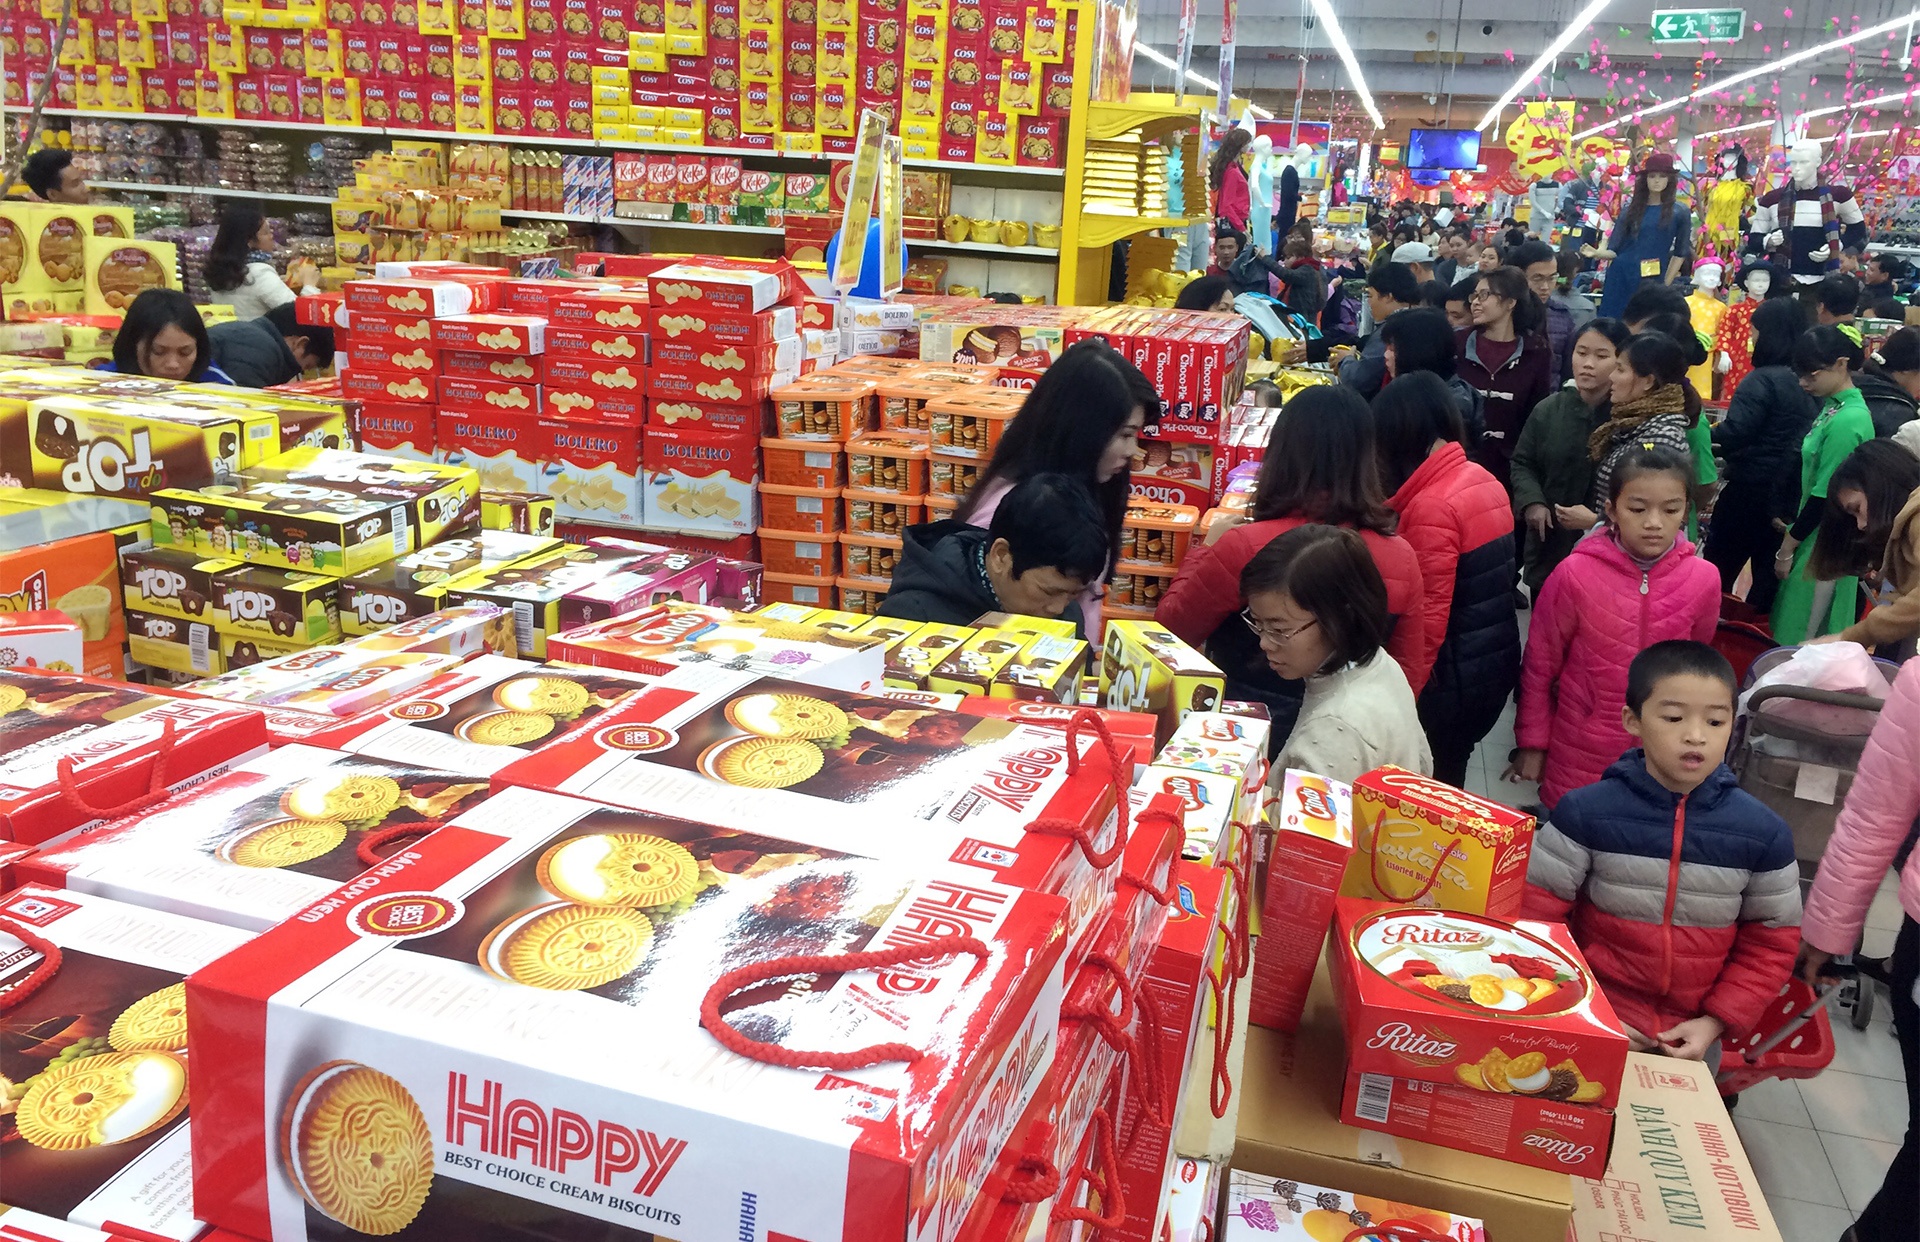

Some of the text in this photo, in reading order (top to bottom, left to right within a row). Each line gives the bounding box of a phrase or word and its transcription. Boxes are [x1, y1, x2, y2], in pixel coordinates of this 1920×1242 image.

[566, 0, 586, 9] COSY
[602, 8, 622, 17] COSY
[714, 4, 734, 14] COSY
[996, 17, 1018, 26] COSY
[866, 24, 875, 48] COSY
[568, 50, 587, 59] COSY
[791, 41, 812, 50] COSY
[954, 48, 976, 59] COSY
[604, 54, 620, 62] COSY
[714, 57, 734, 66] COSY
[865, 66, 874, 89] COSY
[569, 99, 589, 109] COSY
[791, 93, 810, 101] COSY
[951, 101, 972, 111] COSY
[712, 106, 733, 116] COSY
[1028, 125, 1049, 134] COSY
[748, 136, 766, 144] COSY
[620, 163, 645, 179] KitKat
[652, 166, 675, 180] KitKat
[681, 166, 706, 181] KitKat
[713, 167, 738, 184] KitKat
[745, 175, 769, 190] KitKat
[791, 176, 814, 193] KitKat
[884, 311, 908, 320] BOLERO
[454, 423, 517, 441] BOLERO
[554, 433, 618, 453] BOLERO
[663, 443, 731, 461] BOLERO
[62, 427, 164, 492] TOP
[357, 518, 382, 543] TOP
[136, 568, 186, 598] TOP
[223, 591, 276, 621] TOP
[352, 593, 406, 624] TOP
[144, 620, 176, 637] TOP
[631, 614, 704, 644] Cindy
[1385, 860, 1414, 878] Assorted
[341, 877, 380, 899] QUY
[387, 906, 404, 927] CHOICE
[401, 905, 425, 925] BEST
[1381, 922, 1484, 946] Ritaz
[1366, 1022, 1457, 1059] Ritaz
[446, 1071, 689, 1198] HAPPY
[1630, 1103, 1680, 1150] BÁNH
[1523, 1134, 1594, 1164] Ritaz
[1639, 1150, 1692, 1186] QUY
[444, 1151, 682, 1226] BEST CHOICE CREAM BISCUITS
[1630, 1193, 1646, 1221] HOLIDAY
[1658, 1186, 1706, 1230] KEM
